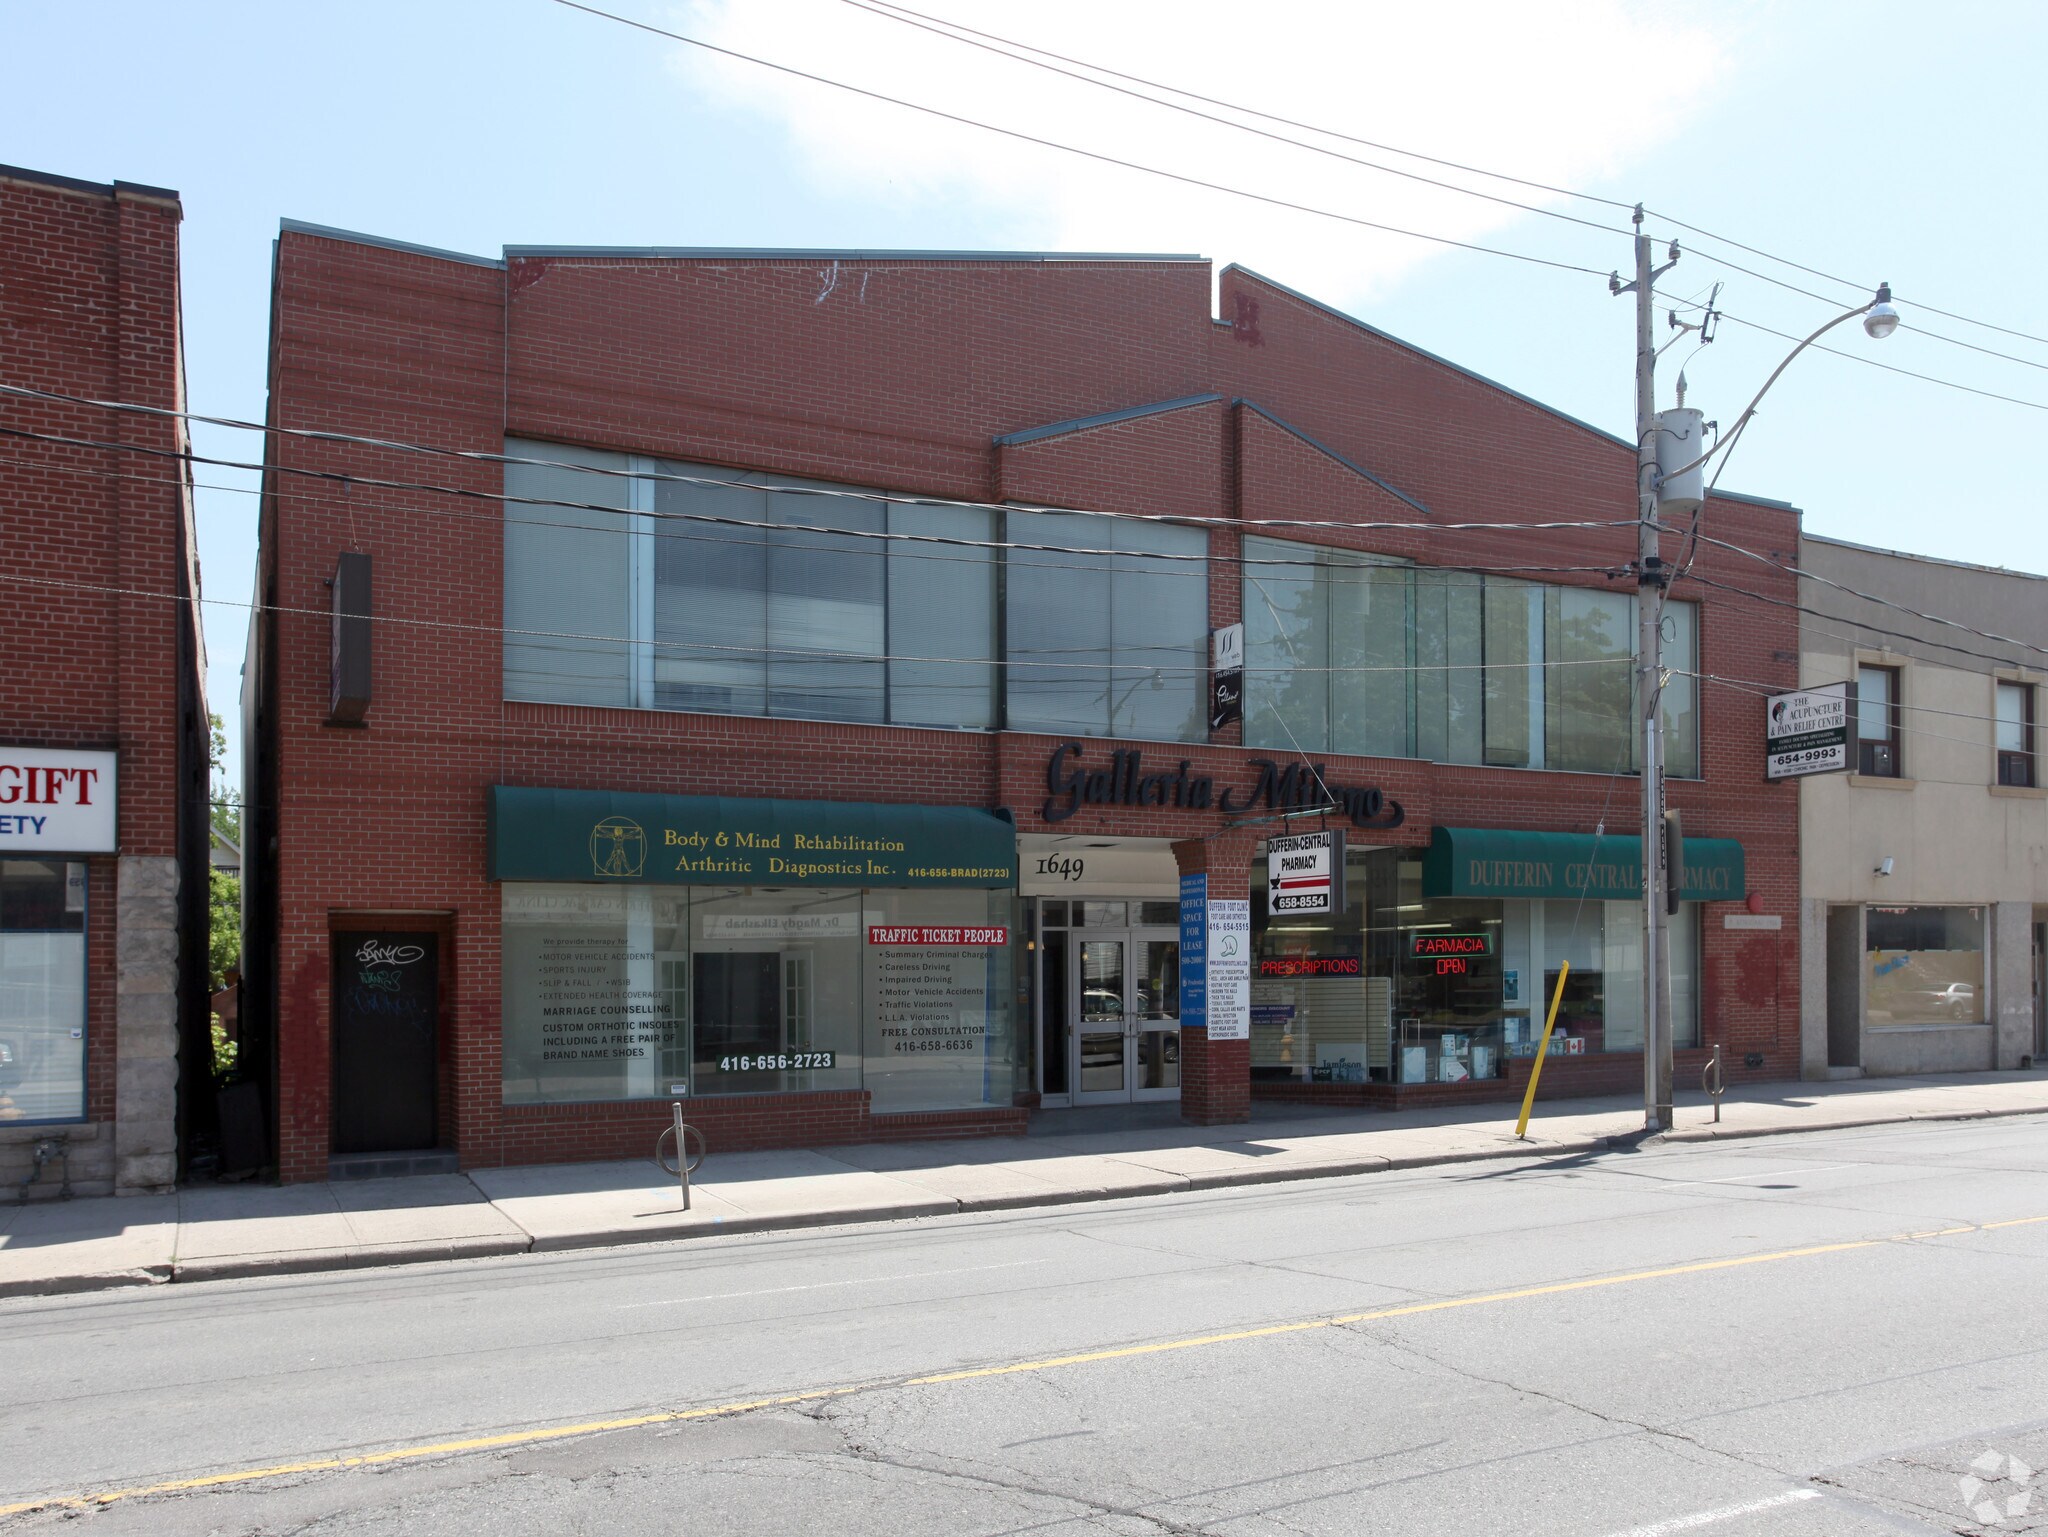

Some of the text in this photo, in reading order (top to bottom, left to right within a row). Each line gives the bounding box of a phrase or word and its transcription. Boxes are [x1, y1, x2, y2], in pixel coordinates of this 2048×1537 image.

[1794, 697, 1809, 706] THE
[1790, 701, 1842, 720] ACUPUNCTURE
[1771, 714, 1843, 736] & PAIN RELIEF CENTRE
[1041, 741, 1404, 828] Galleria Milano
[664, 828, 905, 852] Body & Mind Rehabilitation
[675, 856, 896, 878] Arthritic Diagnostics Inc.
[1036, 852, 1084, 881] 1649
[1281, 854, 1317, 871] PHARMACY
[1470, 860, 1552, 886] DUFFERIN
[1564, 863, 1638, 889] CENTRAL
[1181, 898, 1204, 909] OFFICE
[1209, 901, 1248, 911] DUFFERIN FOOT CLINIC
[1183, 912, 1203, 923] SPACE
[872, 928, 918, 942] TRAFFIC
[922, 929, 961, 942] TICKET
[964, 929, 1004, 943] PEOPLE
[1186, 927, 1199, 937] FOR
[557, 938, 585, 946] provide
[587, 938, 614, 946] therapy
[1183, 941, 1203, 950] LEASE
[1416, 939, 1484, 952] FARMACIA
[543, 952, 655, 961] MOTOR VEHICLE ACCIDENTS
[885, 951, 923, 959] Summary
[962, 951, 992, 959] Charges
[543, 965, 606, 974] SPORTS INJURY
[922, 964, 950, 972] Driving
[1261, 959, 1358, 975] PRESCRIPTIONS
[1437, 959, 1466, 975] OPEN
[543, 979, 562, 987] SLIP
[564, 979, 570, 987] &
[610, 978, 631, 986] WSIB
[885, 976, 952, 985] Impaired Driving
[543, 991, 663, 1000] EXTENDED HEALTH COVERAGE
[543, 1005, 670, 1016] MARRIAGE COUNSELLING
[543, 1020, 679, 1032] CUSTOM ORTHOTIC INSOLES
[882, 1026, 985, 1036] FREE CONSULTATION
[543, 1033, 675, 1046] INCLUDING A FREE PAIR OF
[895, 1040, 973, 1052] 416-658-6636
[543, 1048, 644, 1060] BRAND NAME SHOES
[721, 1053, 831, 1071] 416-656-2723
[1323, 1058, 1362, 1069] Jamieson
